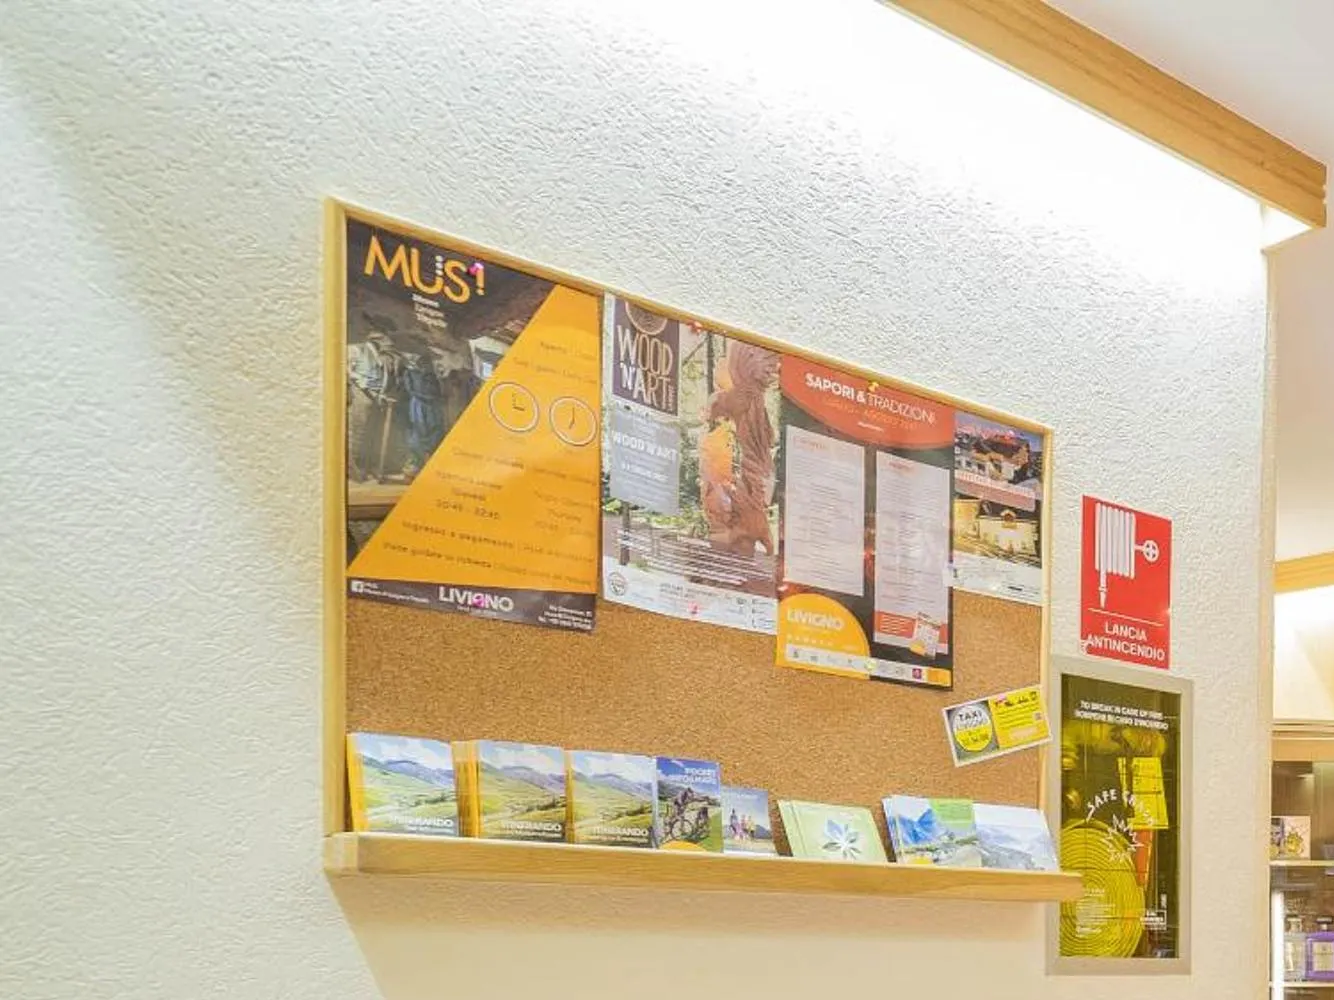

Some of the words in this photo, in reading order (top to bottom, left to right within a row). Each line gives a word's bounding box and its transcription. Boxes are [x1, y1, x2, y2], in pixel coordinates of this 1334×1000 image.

[616, 324, 673, 376] WOOD
[804, 372, 855, 400] SAPORI
[856, 390, 866, 403] &
[1104, 620, 1148, 641] LANCIA
[1087, 633, 1166, 661] ANTINCENDIO
